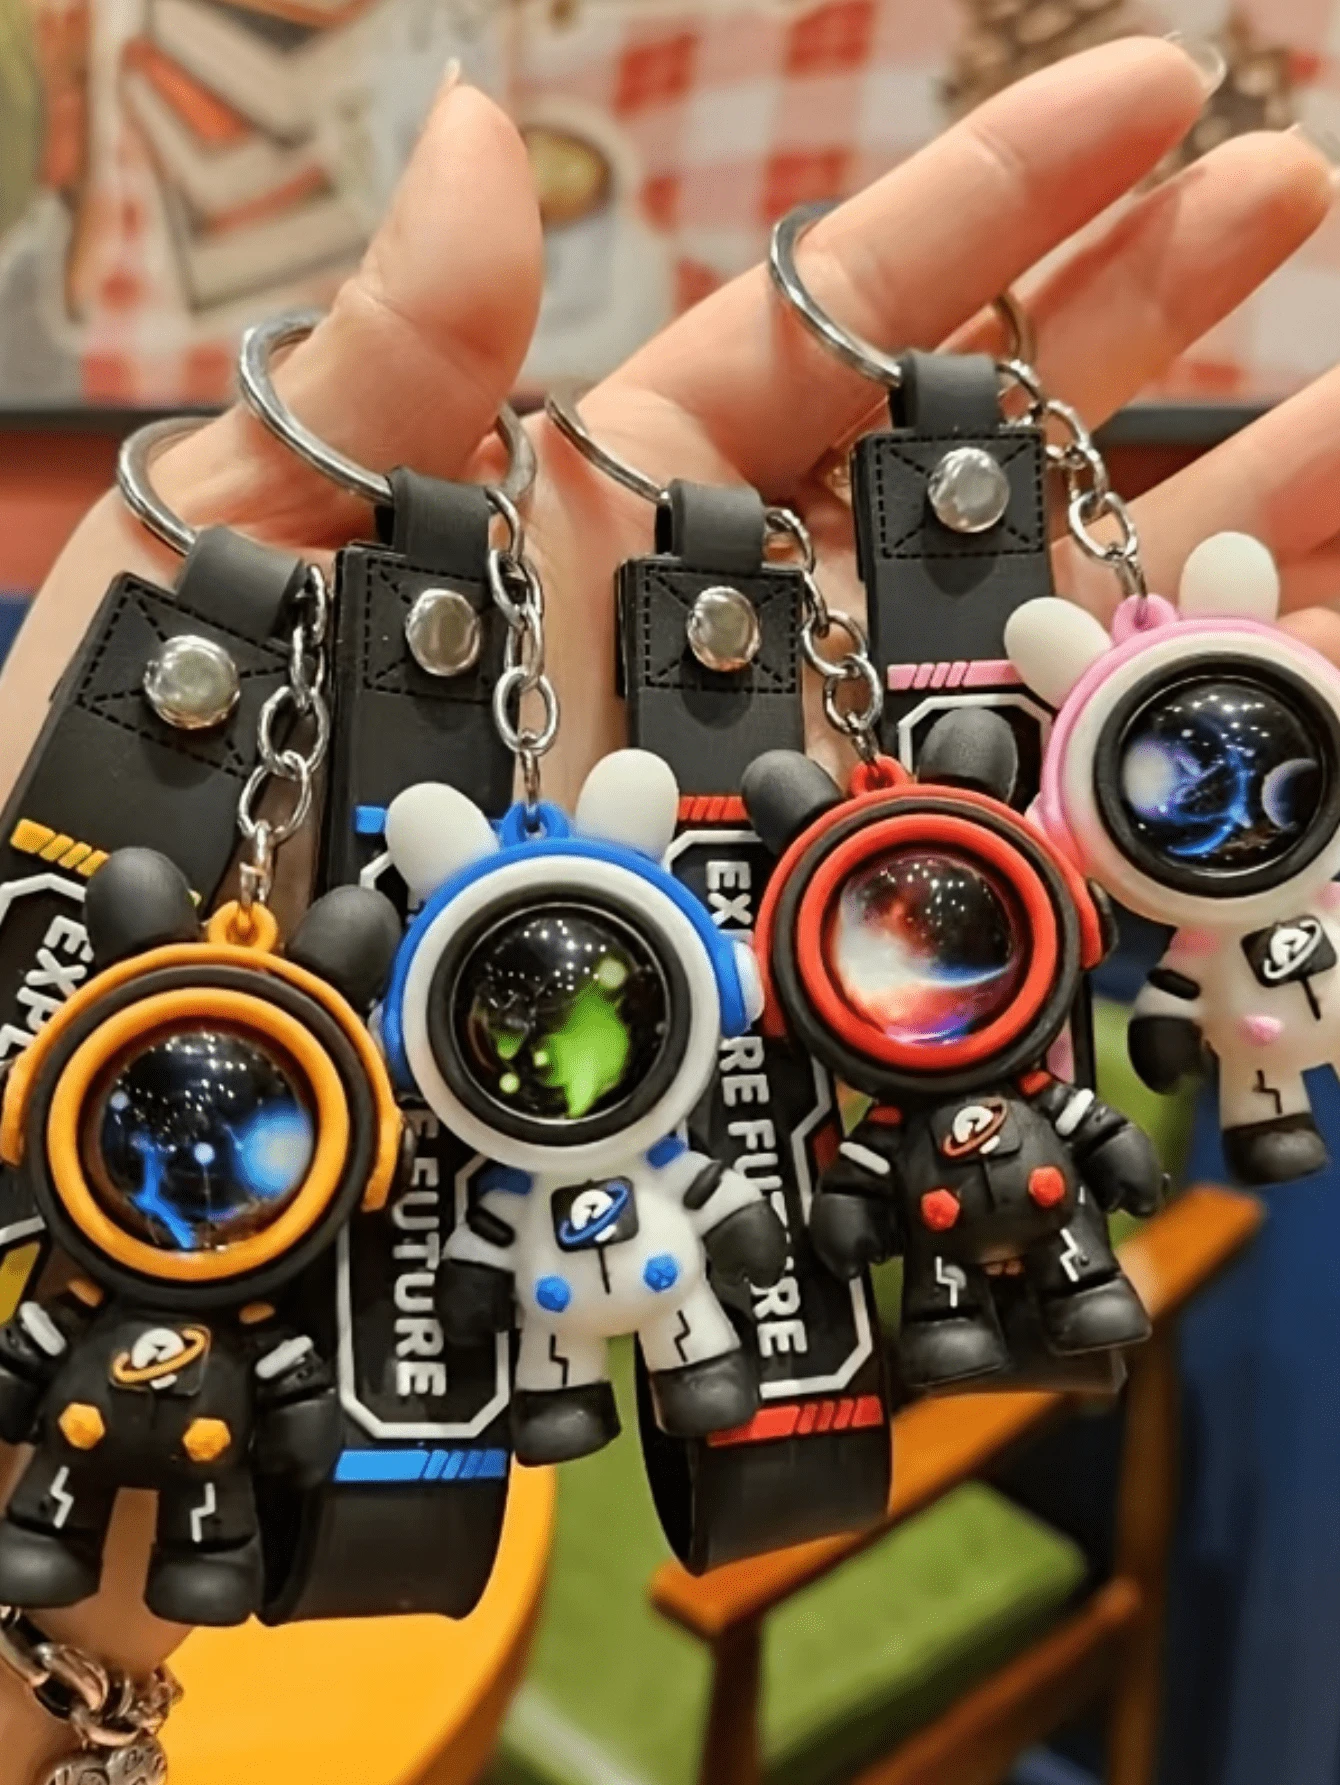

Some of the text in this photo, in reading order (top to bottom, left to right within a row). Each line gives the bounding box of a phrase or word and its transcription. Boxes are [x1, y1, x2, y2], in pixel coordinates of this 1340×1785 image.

[0, 914, 94, 1066] EXPL
[391, 1157, 446, 1396] FUTURE
[728, 1119, 807, 1358] FURE
